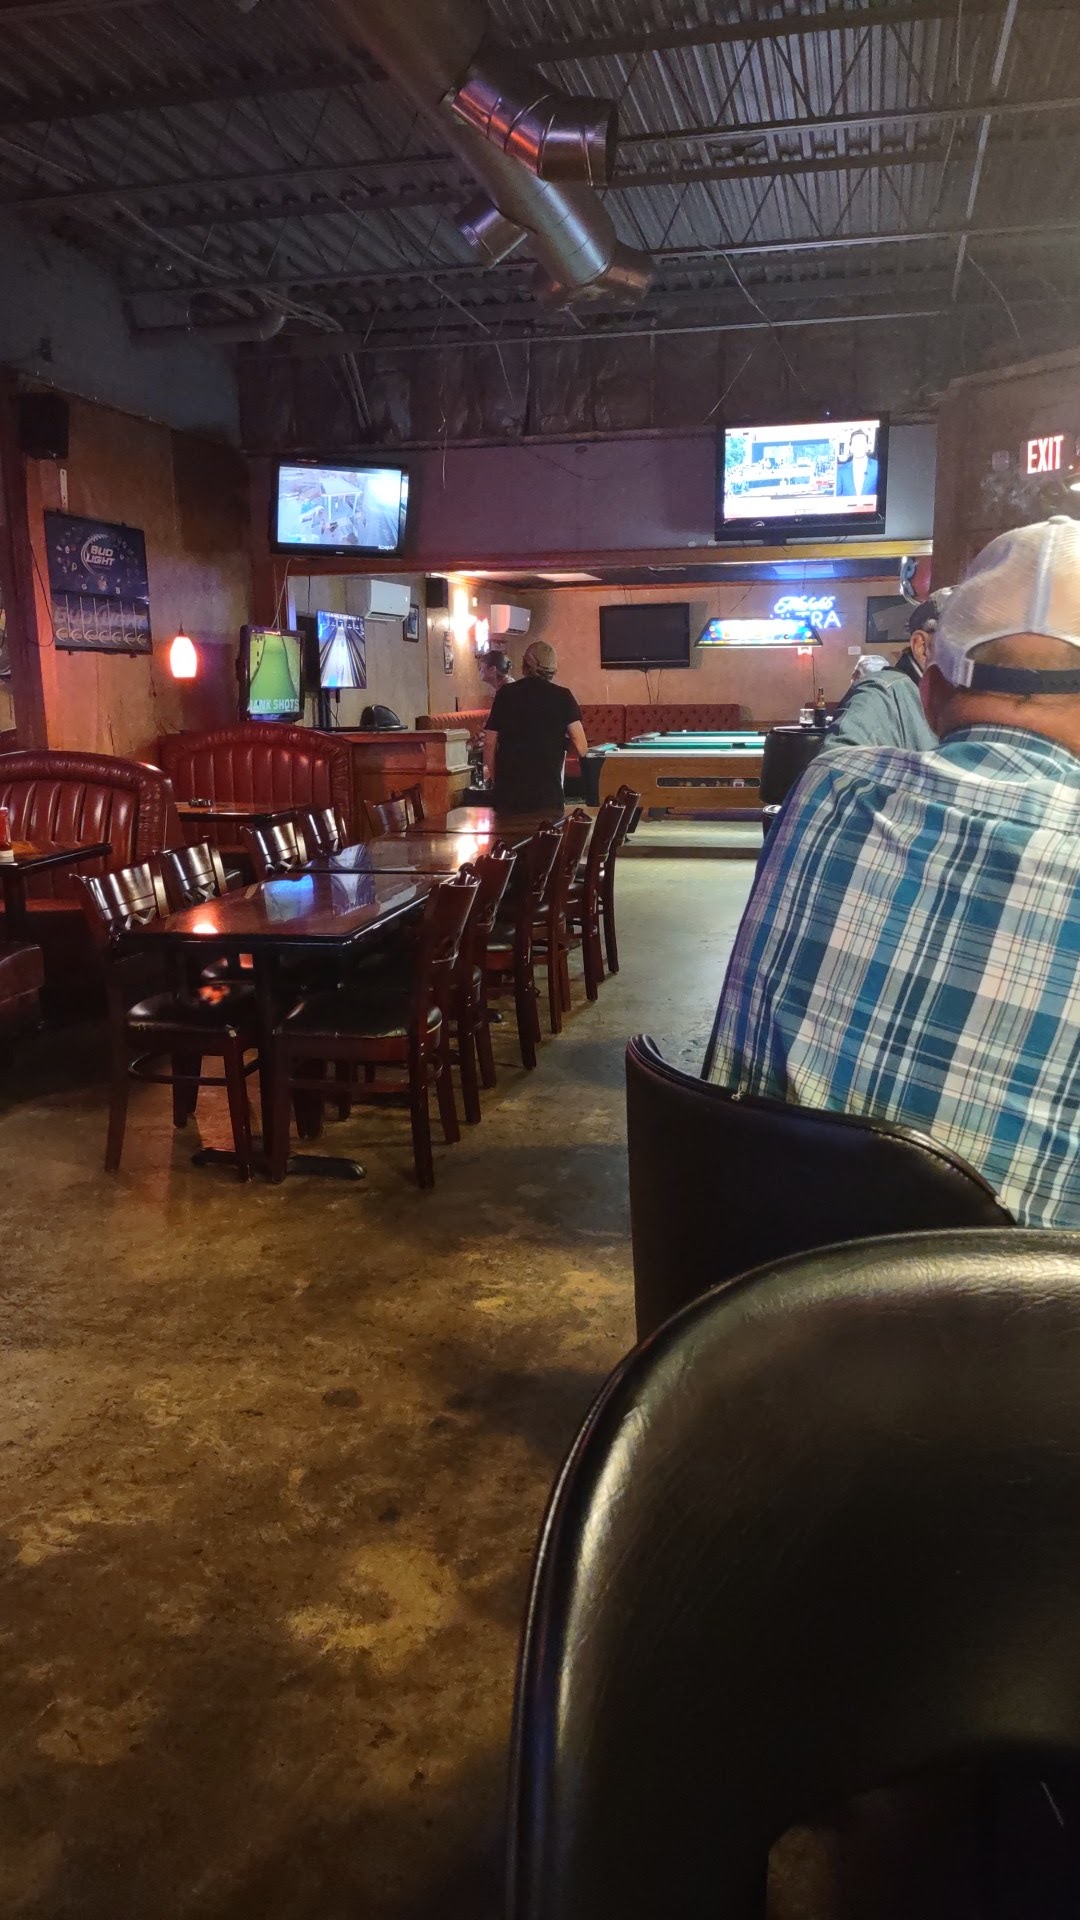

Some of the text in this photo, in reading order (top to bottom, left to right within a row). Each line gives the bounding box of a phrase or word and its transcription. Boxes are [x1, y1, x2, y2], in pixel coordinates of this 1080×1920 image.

[1027, 435, 1064, 474] EXIT
[90, 545, 114, 557] BUD
[85, 552, 115, 566] LIGHT
[273, 698, 299, 710] SHOTS
